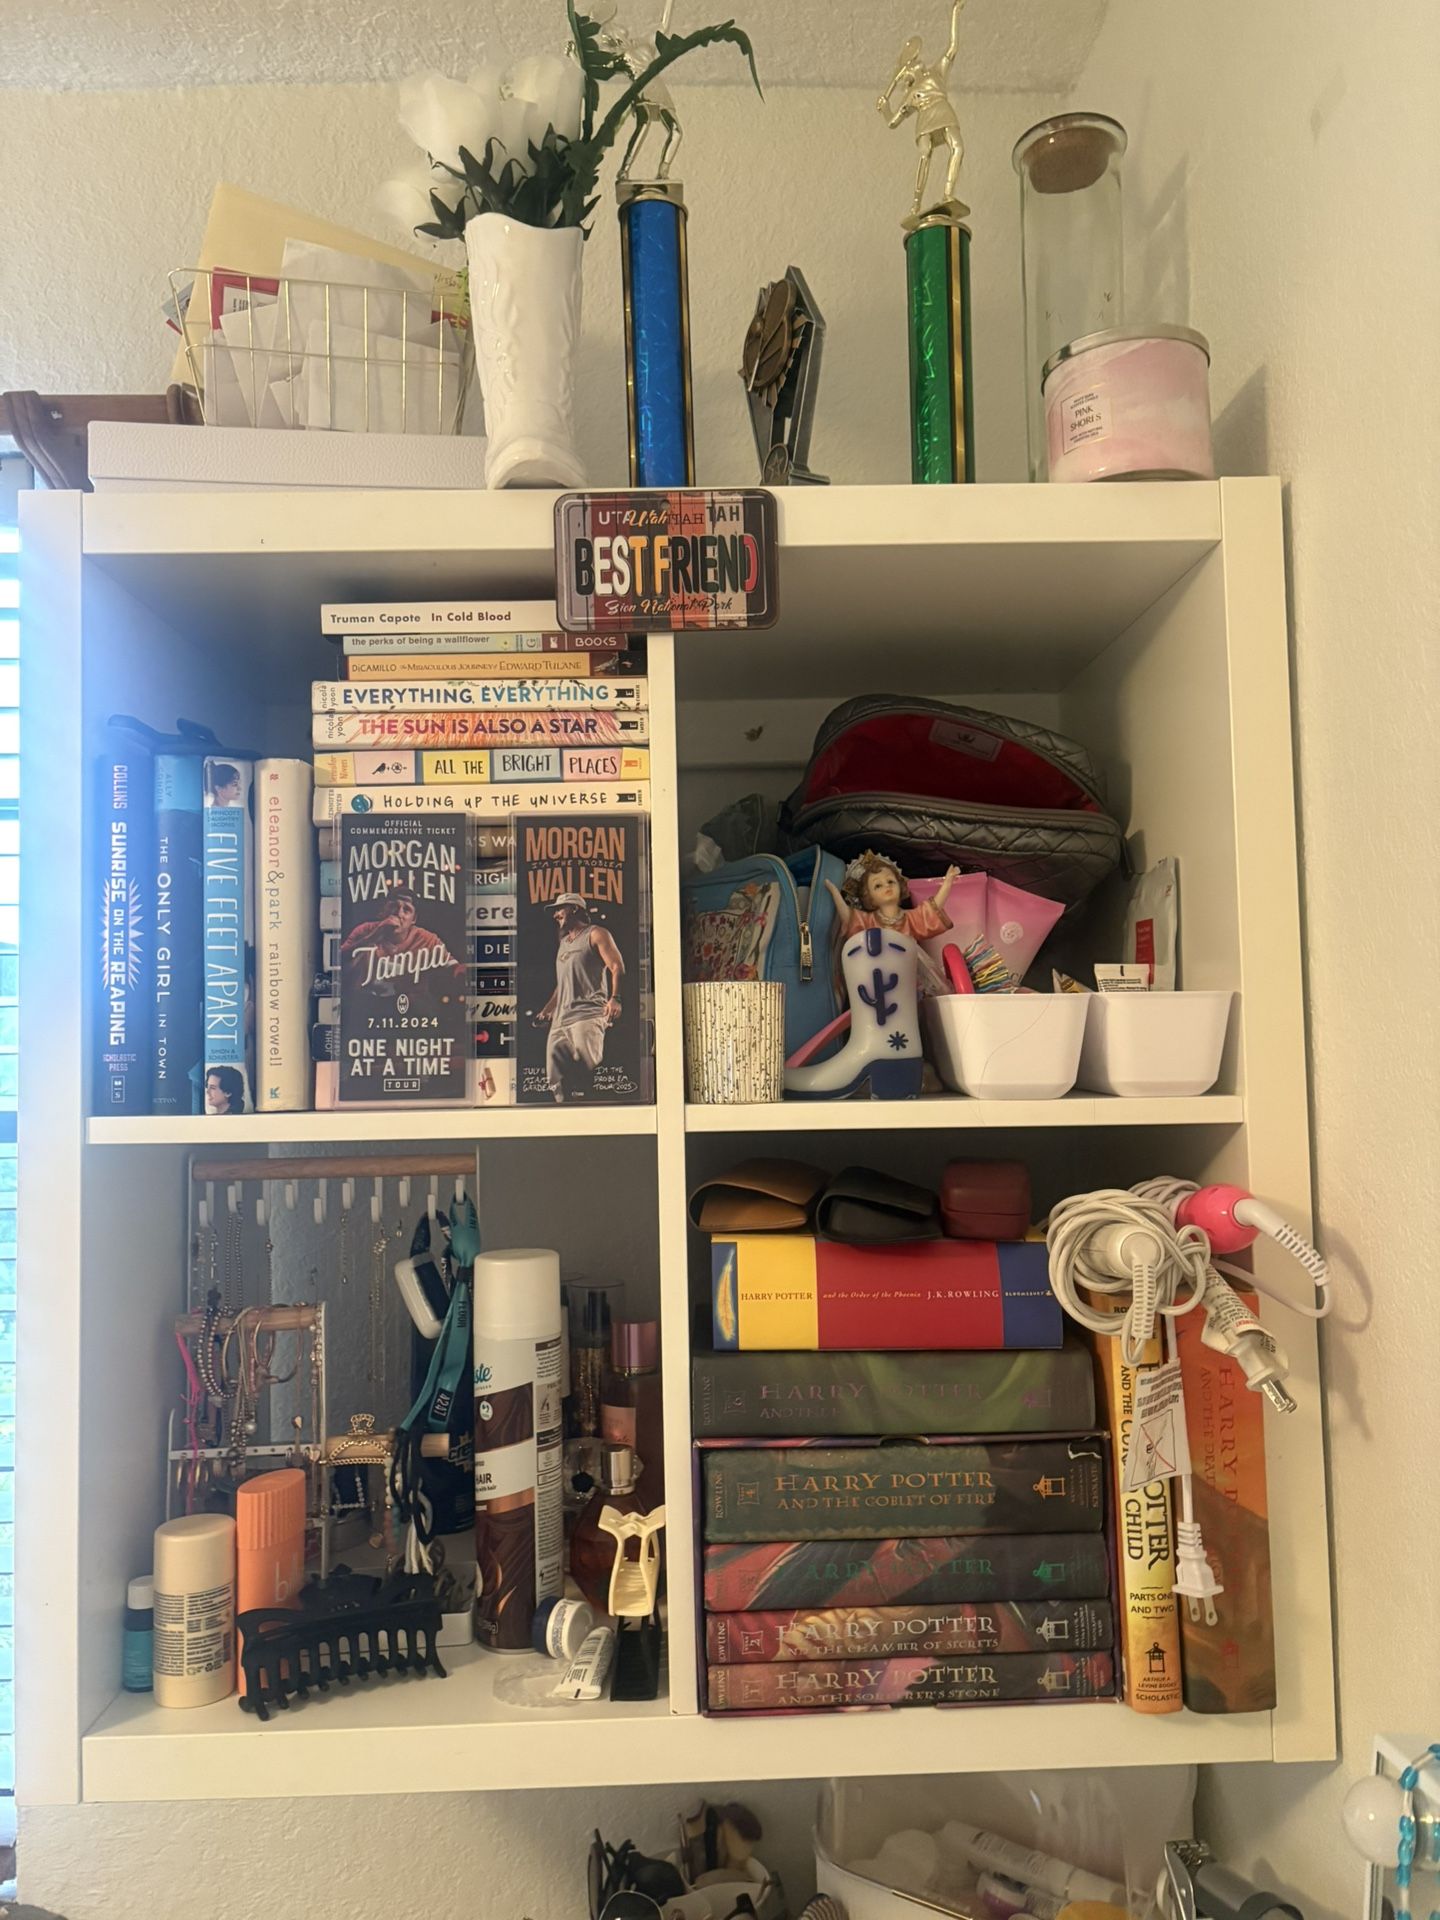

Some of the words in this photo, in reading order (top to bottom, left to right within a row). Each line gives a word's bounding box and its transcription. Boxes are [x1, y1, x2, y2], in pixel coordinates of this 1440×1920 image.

[574, 535, 648, 596] BEST
[653, 534, 759, 595] FRIEND
[330, 614, 375, 624] Truman
[379, 613, 421, 625] Capote
[431, 612, 442, 622] In
[447, 611, 473, 621] Cold
[478, 611, 512, 621] Blood
[604, 599, 636, 615] Zion
[351, 637, 366, 646] the
[369, 637, 394, 647] perks
[396, 636, 406, 645] of
[408, 636, 434, 646] being
[445, 635, 490, 644] wallflower
[575, 637, 617, 647] BOOKS
[352, 663, 397, 673] DiCAMILLO
[499, 660, 542, 672] EDWARD
[541, 660, 582, 670] TULANE
[330, 687, 338, 707] yoon
[481, 685, 609, 703] EVERYTHING
[326, 714, 334, 739] nicola
[337, 716, 345, 737] yoon
[359, 719, 399, 735] THE
[403, 719, 446, 735] SUN
[452, 719, 469, 734] IS
[473, 718, 527, 734] ALSO
[530, 719, 545, 734] A
[549, 718, 598, 734] STAR
[434, 759, 457, 775] ALL
[463, 760, 485, 775] THE
[502, 754, 553, 772] BRIGHT
[568, 756, 618, 775] PLACES
[113, 764, 128, 809] COLLINS
[165, 773, 173, 798] ALLY
[383, 794, 454, 808] HOLDING
[492, 794, 520, 807] THE
[268, 795, 282, 868] eleanor
[350, 827, 423, 835] COMMEMORATIVE
[426, 827, 457, 835] TICKET
[160, 836, 168, 863] THE
[525, 826, 625, 862] MORGAN
[111, 821, 127, 902] SUNRISE
[206, 832, 239, 886] FIVE
[348, 839, 456, 874] MORGAN
[265, 870, 285, 885] &
[527, 867, 623, 905] WALLEN
[157, 872, 172, 935] ONLY
[265, 888, 283, 930] park
[113, 908, 124, 925] ON
[206, 898, 239, 956] FEET
[113, 930, 124, 955] THE
[484, 943, 511, 955] DIE
[156, 946, 171, 1003] GIRL
[352, 943, 451, 986] Tampa
[268, 942, 282, 1011] rainbow
[110, 961, 126, 1046] REAPING
[206, 963, 239, 1045] APART
[158, 1013, 167, 1028] IN
[368, 1017, 439, 1029] 7.11.2024
[268, 1016, 283, 1067] rowell
[348, 1039, 387, 1057] ONE
[396, 1038, 455, 1057] NIGHT
[158, 1037, 167, 1079] TOWN
[350, 1058, 375, 1076] AT
[382, 1058, 396, 1076] A
[403, 1058, 451, 1076] TIME
[387, 1081, 417, 1089] TOUR
[741, 1292, 774, 1301] HARRY
[775, 1291, 813, 1300] POTTER
[822, 1291, 836, 1299] and
[850, 1291, 871, 1299] Order
[872, 1290, 880, 1299] of
[881, 1290, 892, 1298] the
[1120, 1365, 1131, 1391] AND
[1201, 1367, 1212, 1399] AND
[760, 1384, 866, 1401] HARRY
[882, 1384, 983, 1401] TTER
[1123, 1392, 1132, 1415] THE
[1202, 1407, 1214, 1439] THE
[1219, 1368, 1239, 1477] HARRY
[775, 1472, 881, 1493] HARRY
[890, 1471, 994, 1489] POTTER
[777, 1497, 818, 1511] AND
[823, 1495, 860, 1508] THE
[864, 1494, 926, 1507] GOBLET
[929, 1493, 951, 1506] OF
[956, 1491, 996, 1505] FIRE
[1125, 1499, 1144, 1561] CHILD
[1143, 1480, 1170, 1570] OTTER
[776, 1559, 875, 1581] ARRY
[1129, 1592, 1156, 1601] PARTS
[1157, 1592, 1174, 1601] ONE
[1131, 1605, 1152, 1614] AND
[1154, 1605, 1175, 1614] TWO
[775, 1619, 884, 1642] HARRY
[891, 1616, 998, 1636] POTTER
[751, 1638, 760, 1648] 2
[815, 1645, 845, 1655] THE
[847, 1641, 919, 1653] CHAMBER
[923, 1640, 940, 1650] OF
[946, 1638, 999, 1649] SECRETS
[775, 1668, 884, 1690] HARRY
[893, 1665, 999, 1686] POTTER
[778, 1694, 815, 1705] AND
[817, 1692, 853, 1703] THE
[949, 1687, 1000, 1699] STONE
